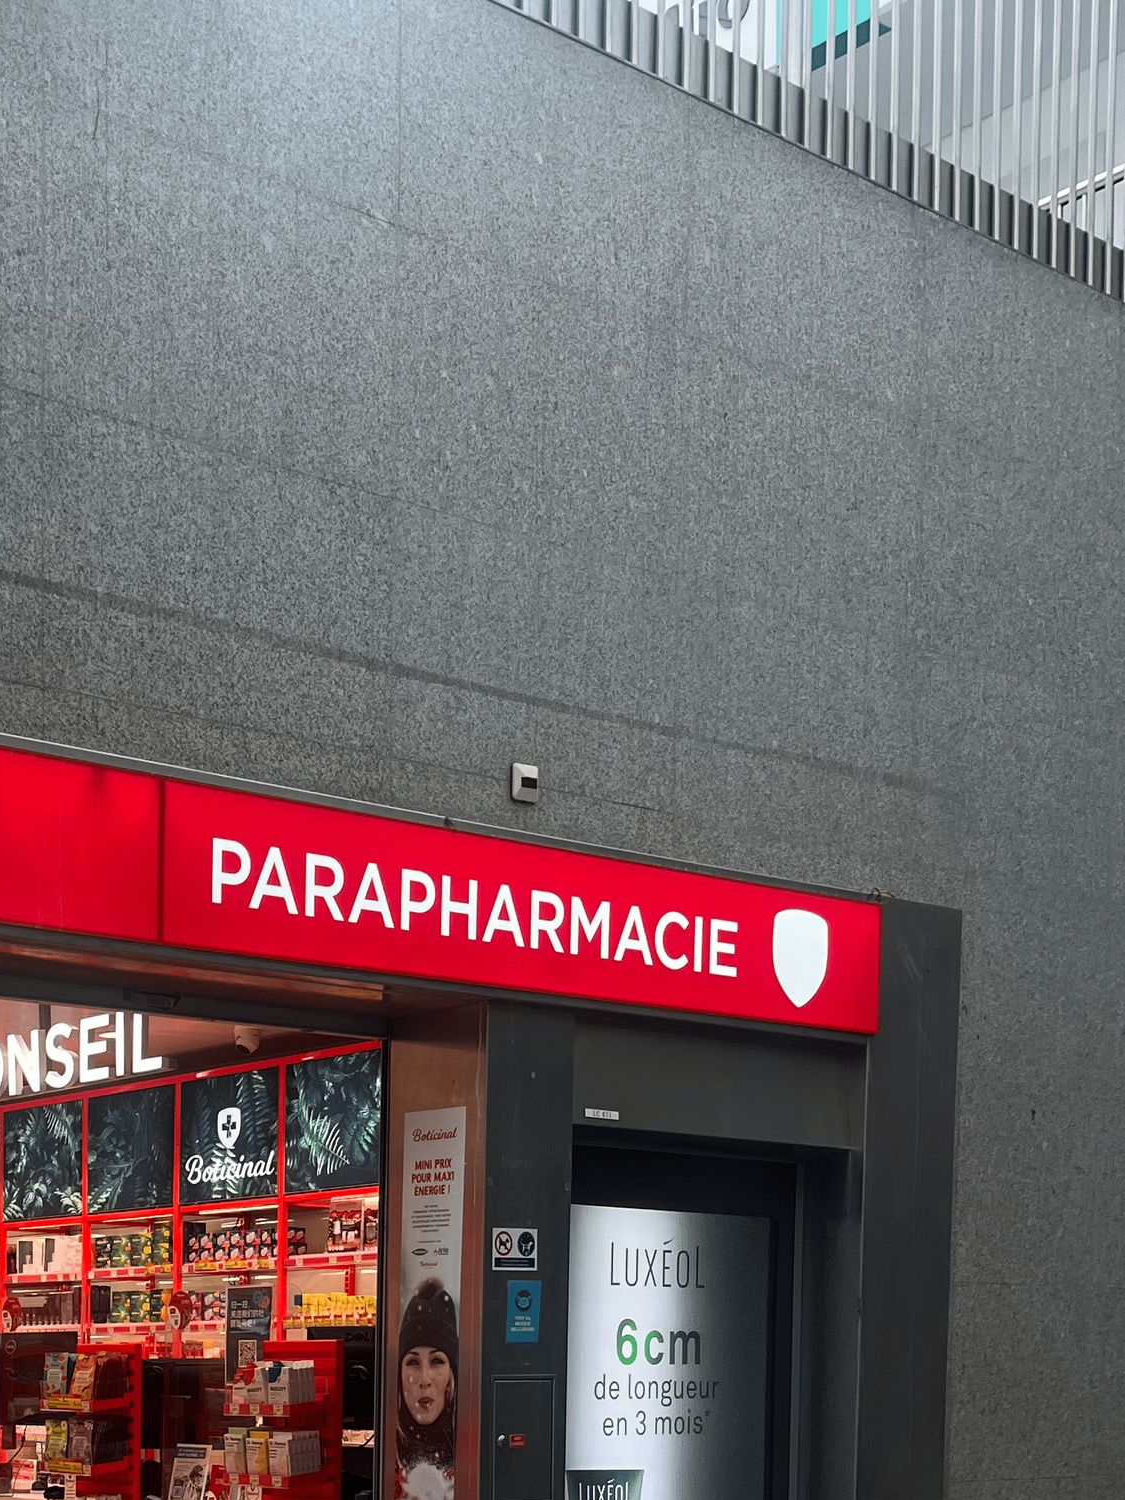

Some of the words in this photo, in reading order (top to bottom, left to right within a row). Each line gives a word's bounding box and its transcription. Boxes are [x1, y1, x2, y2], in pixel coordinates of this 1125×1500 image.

[211, 837, 739, 977] PARAPHARMACIE
[412, 1126, 458, 1143] Boticinal
[185, 1149, 276, 1185] Boticinal
[411, 1172, 432, 1184] POUR
[433, 1170, 455, 1183] MAXI
[414, 1159, 433, 1171] MINI
[434, 1158, 453, 1170] PRIX
[414, 1184, 446, 1197] ÉNERGIE
[610, 1238, 705, 1289] LUXÉOL
[616, 1317, 702, 1366] 6cm
[594, 1373, 620, 1400] de
[628, 1374, 720, 1407] longueur
[603, 1415, 627, 1436] en
[635, 1410, 647, 1436] 3
